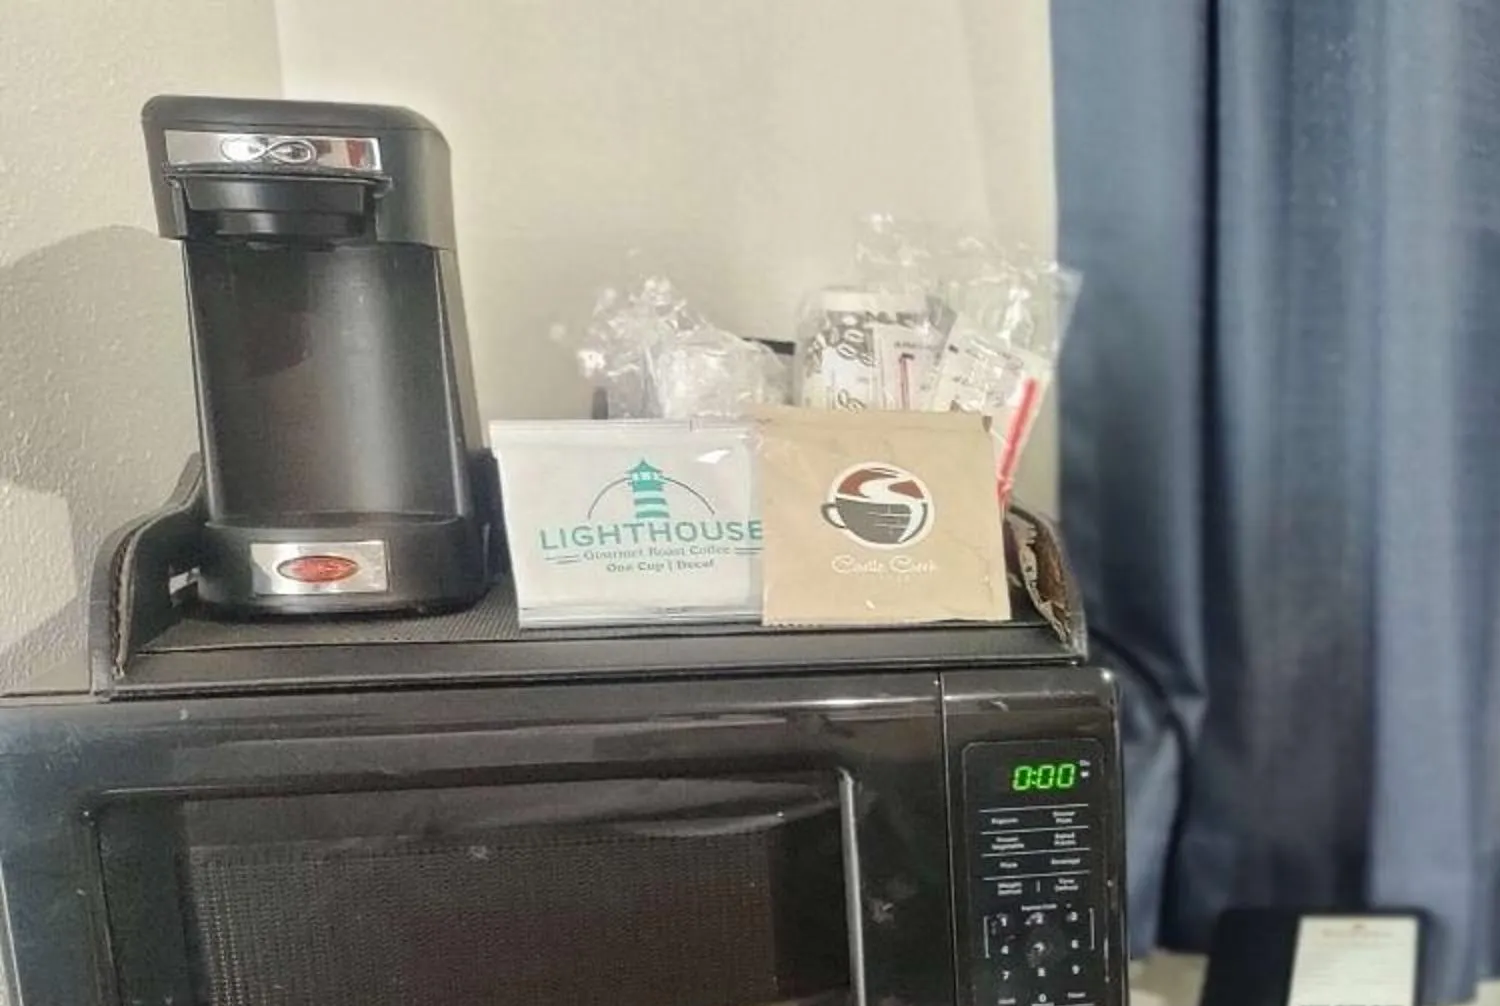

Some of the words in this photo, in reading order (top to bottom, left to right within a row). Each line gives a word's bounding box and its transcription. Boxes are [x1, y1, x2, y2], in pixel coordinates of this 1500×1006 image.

[540, 519, 763, 550] LIGHTHOUSE
[606, 563, 633, 572] One
[638, 561, 665, 572] Cup
[1012, 763, 1076, 791] 0:00
